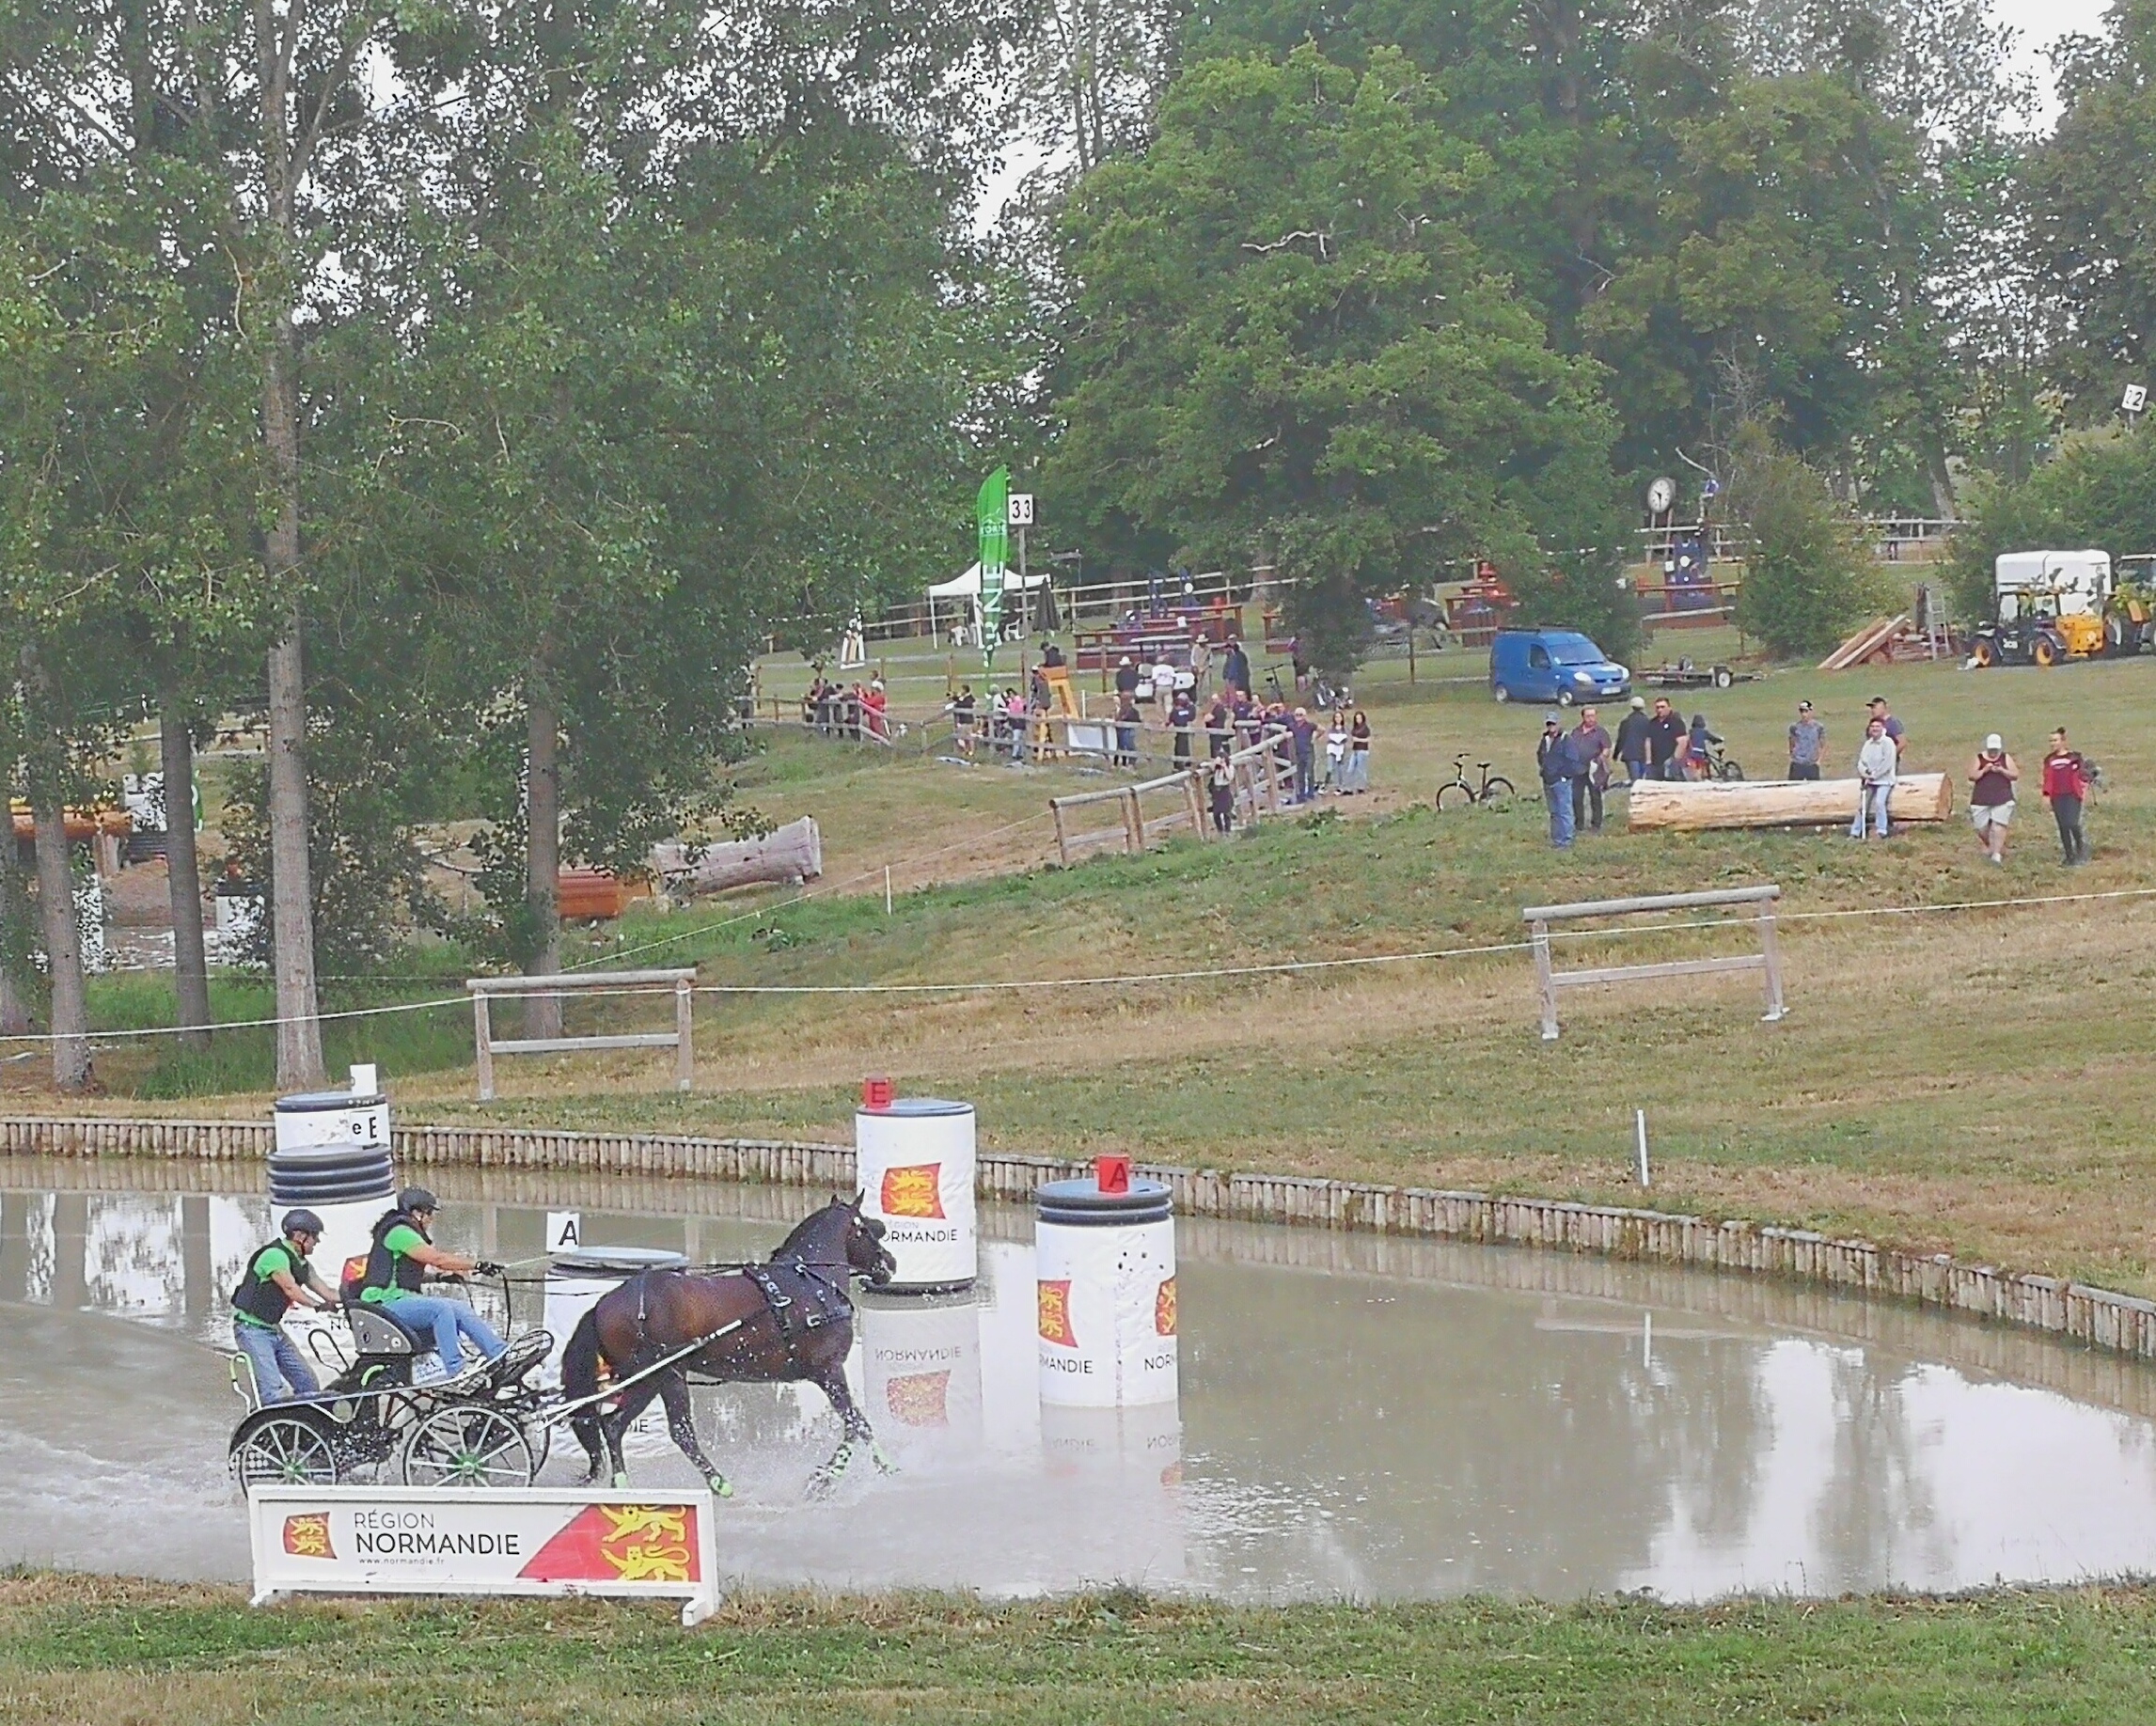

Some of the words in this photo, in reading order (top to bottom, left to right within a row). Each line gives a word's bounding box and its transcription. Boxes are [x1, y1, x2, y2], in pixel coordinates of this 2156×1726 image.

[872, 1082, 887, 1104] E
[1109, 1163, 1128, 1187] A
[559, 1220, 577, 1246] A
[884, 1229, 958, 1242] ORMANDIE
[354, 1509, 434, 1529] RÉGION
[356, 1532, 520, 1555] NORMANDIE
[359, 1557, 445, 1565] www.normandie.fr
